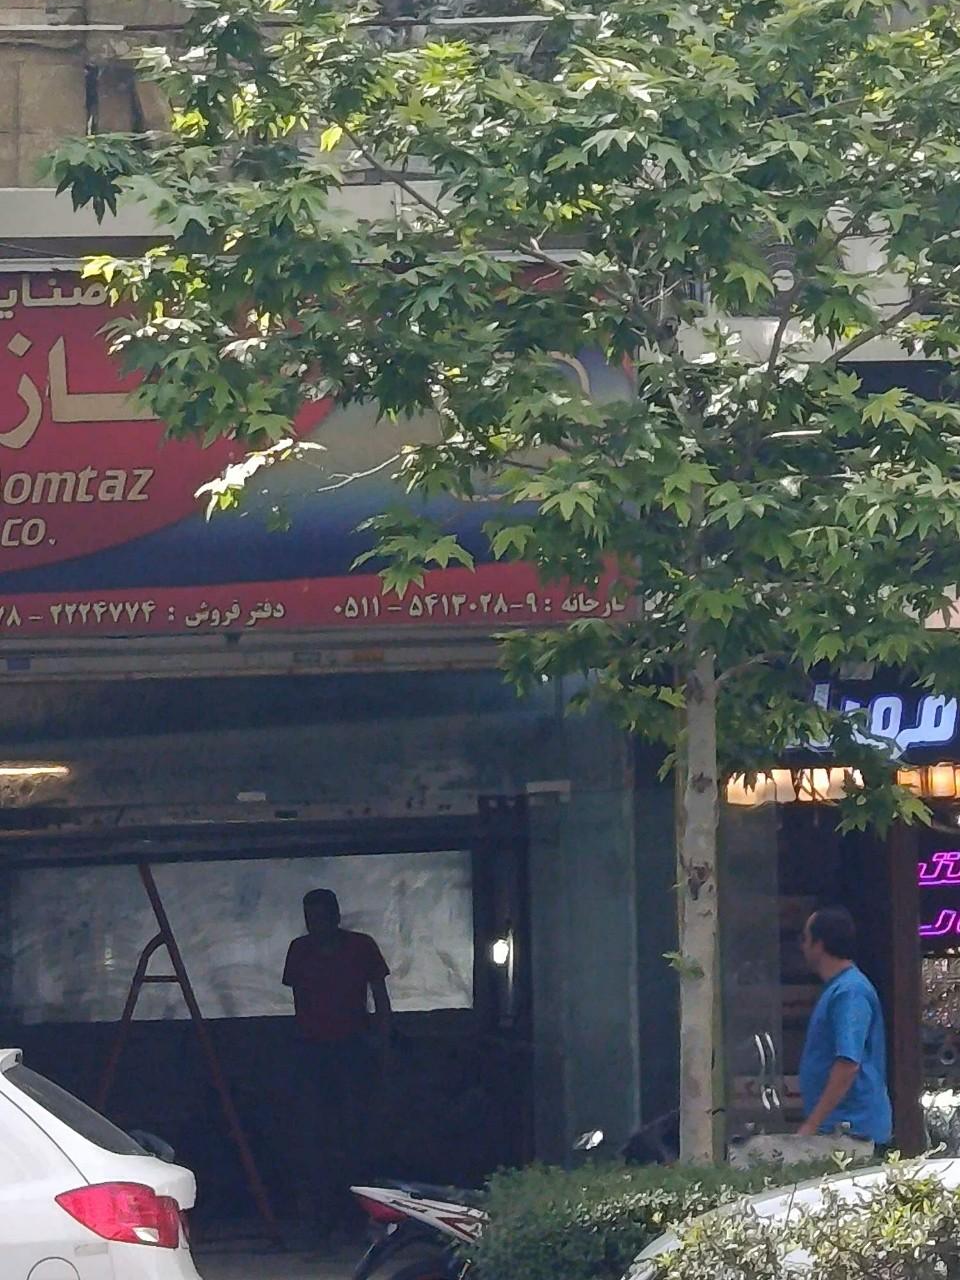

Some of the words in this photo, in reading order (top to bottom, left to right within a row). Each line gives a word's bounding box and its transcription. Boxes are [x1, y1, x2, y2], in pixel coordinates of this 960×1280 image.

[2, 465, 154, 505] omtaz
[185, 599, 241, 628] فروش
[246, 597, 285, 627] دفتر
